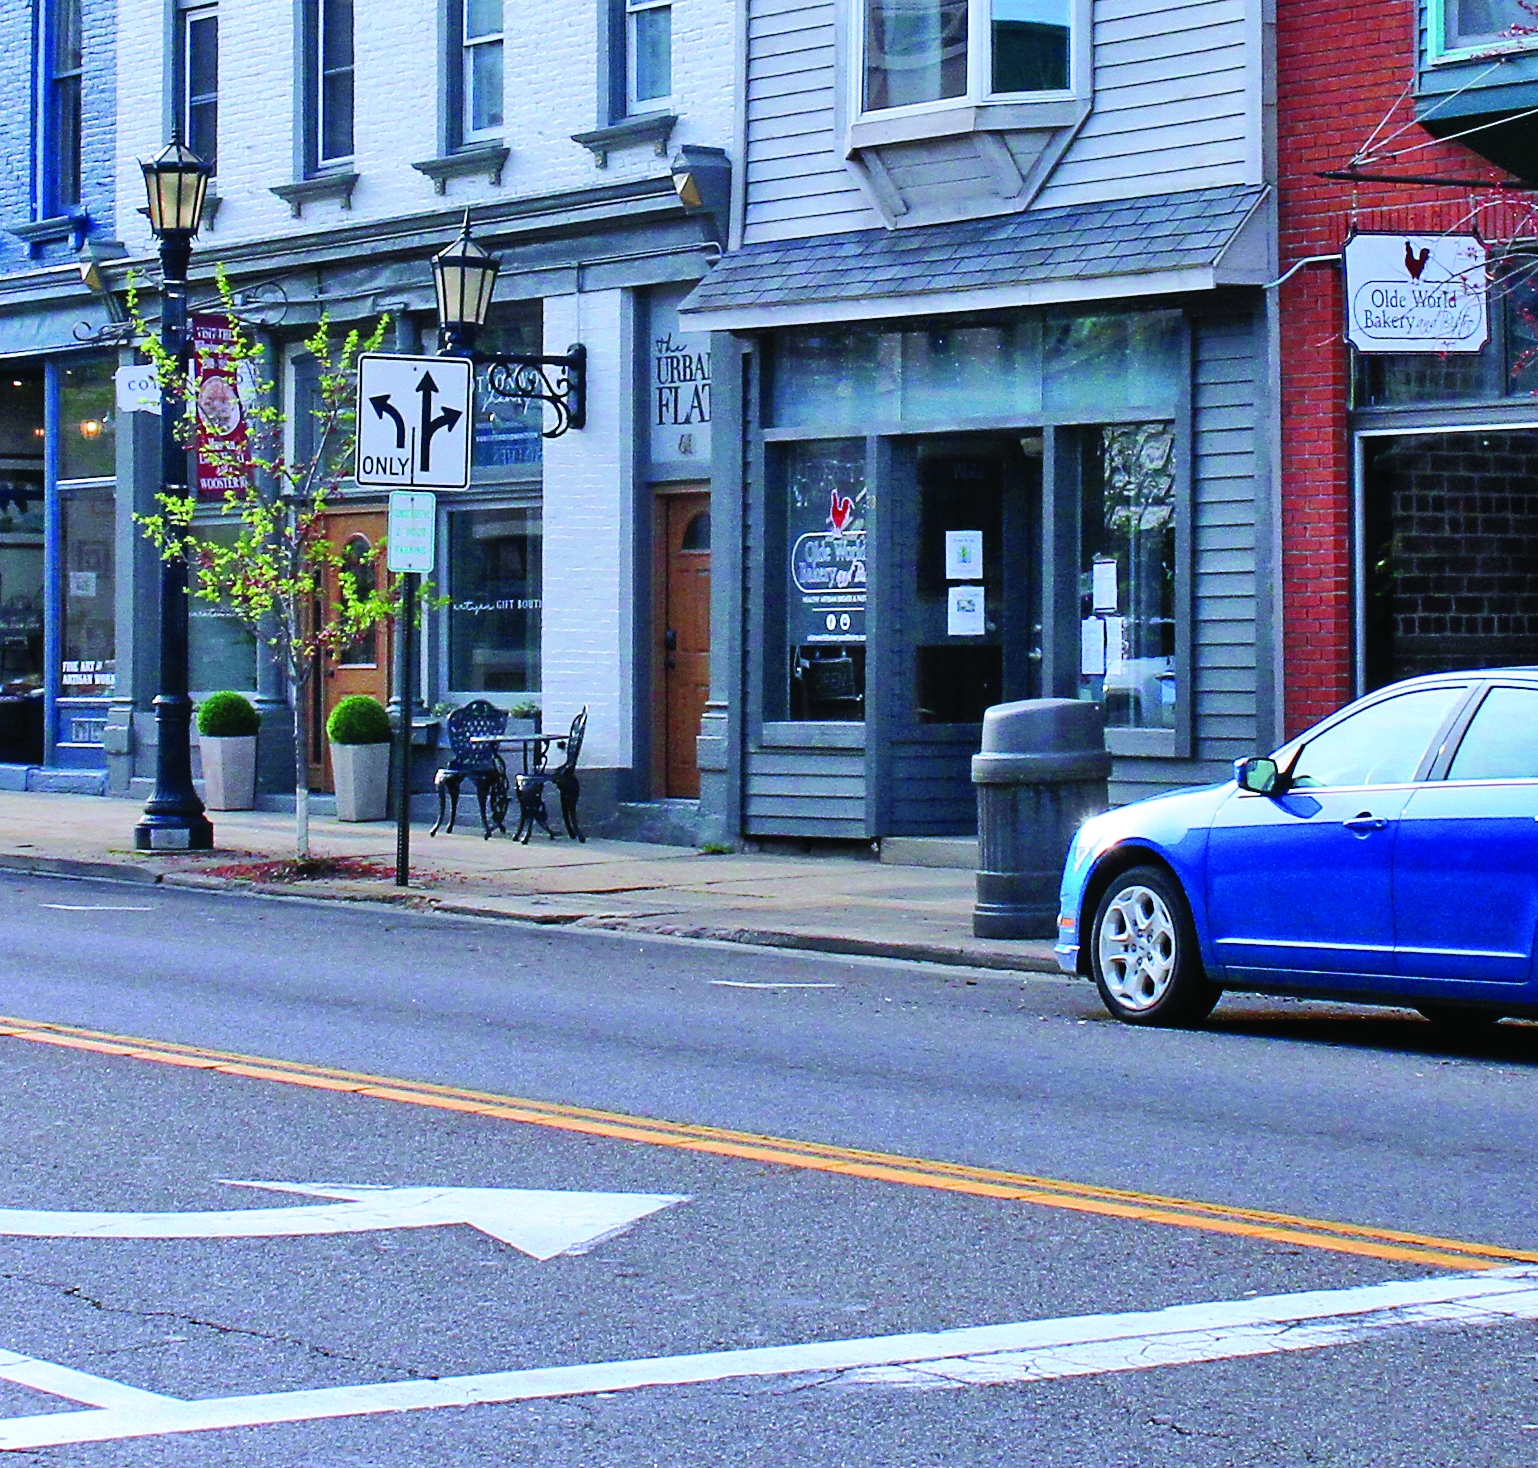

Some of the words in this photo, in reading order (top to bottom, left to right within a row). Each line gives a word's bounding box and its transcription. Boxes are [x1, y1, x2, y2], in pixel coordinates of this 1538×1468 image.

[1371, 289, 1406, 308] Olde
[1412, 289, 1457, 308] World
[1364, 310, 1414, 334] Bakery
[363, 456, 409, 476] ONLY
[200, 477, 239, 489] WOOSTER
[496, 599, 514, 609] GIFT
[517, 599, 541, 609] BOUTI
[62, 661, 79, 672] FINE
[80, 661, 95, 672] ART
[62, 673, 93, 685] ARTISAN
